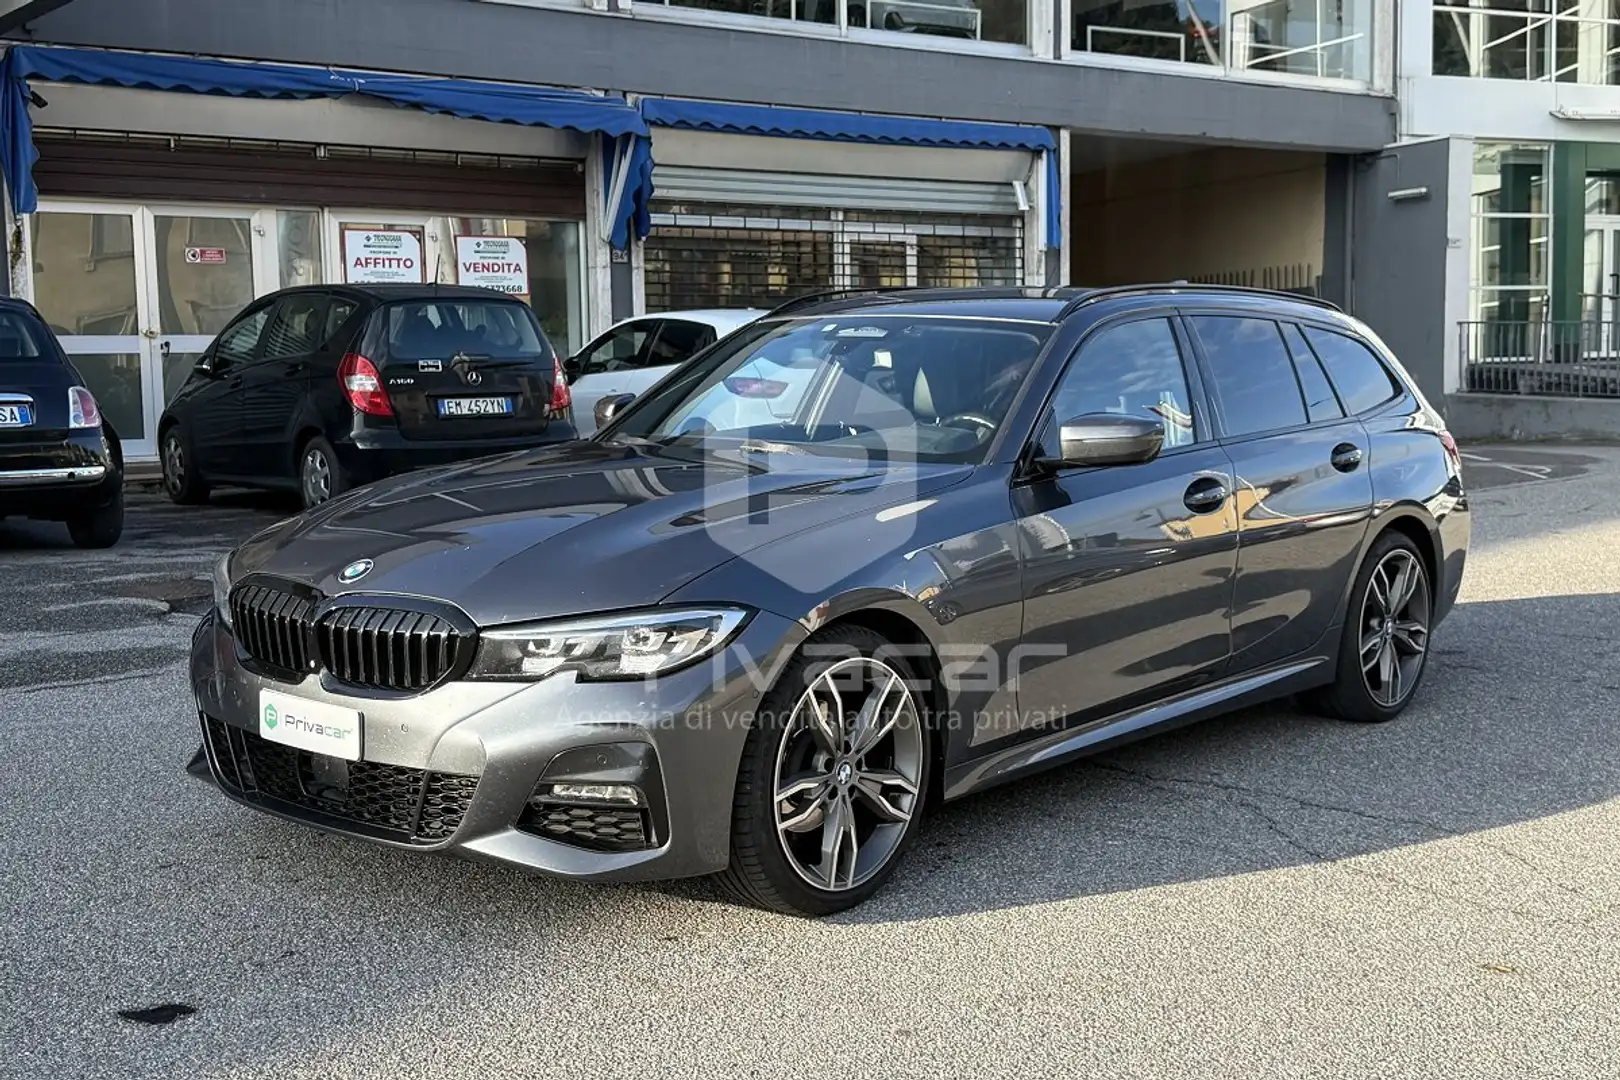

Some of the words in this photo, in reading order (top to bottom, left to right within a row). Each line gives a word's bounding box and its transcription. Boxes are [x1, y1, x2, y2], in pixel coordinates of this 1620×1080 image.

[354, 257, 414, 269] AFFITTO
[462, 262, 523, 273] VENDITA
[284, 714, 352, 738] Privacar
